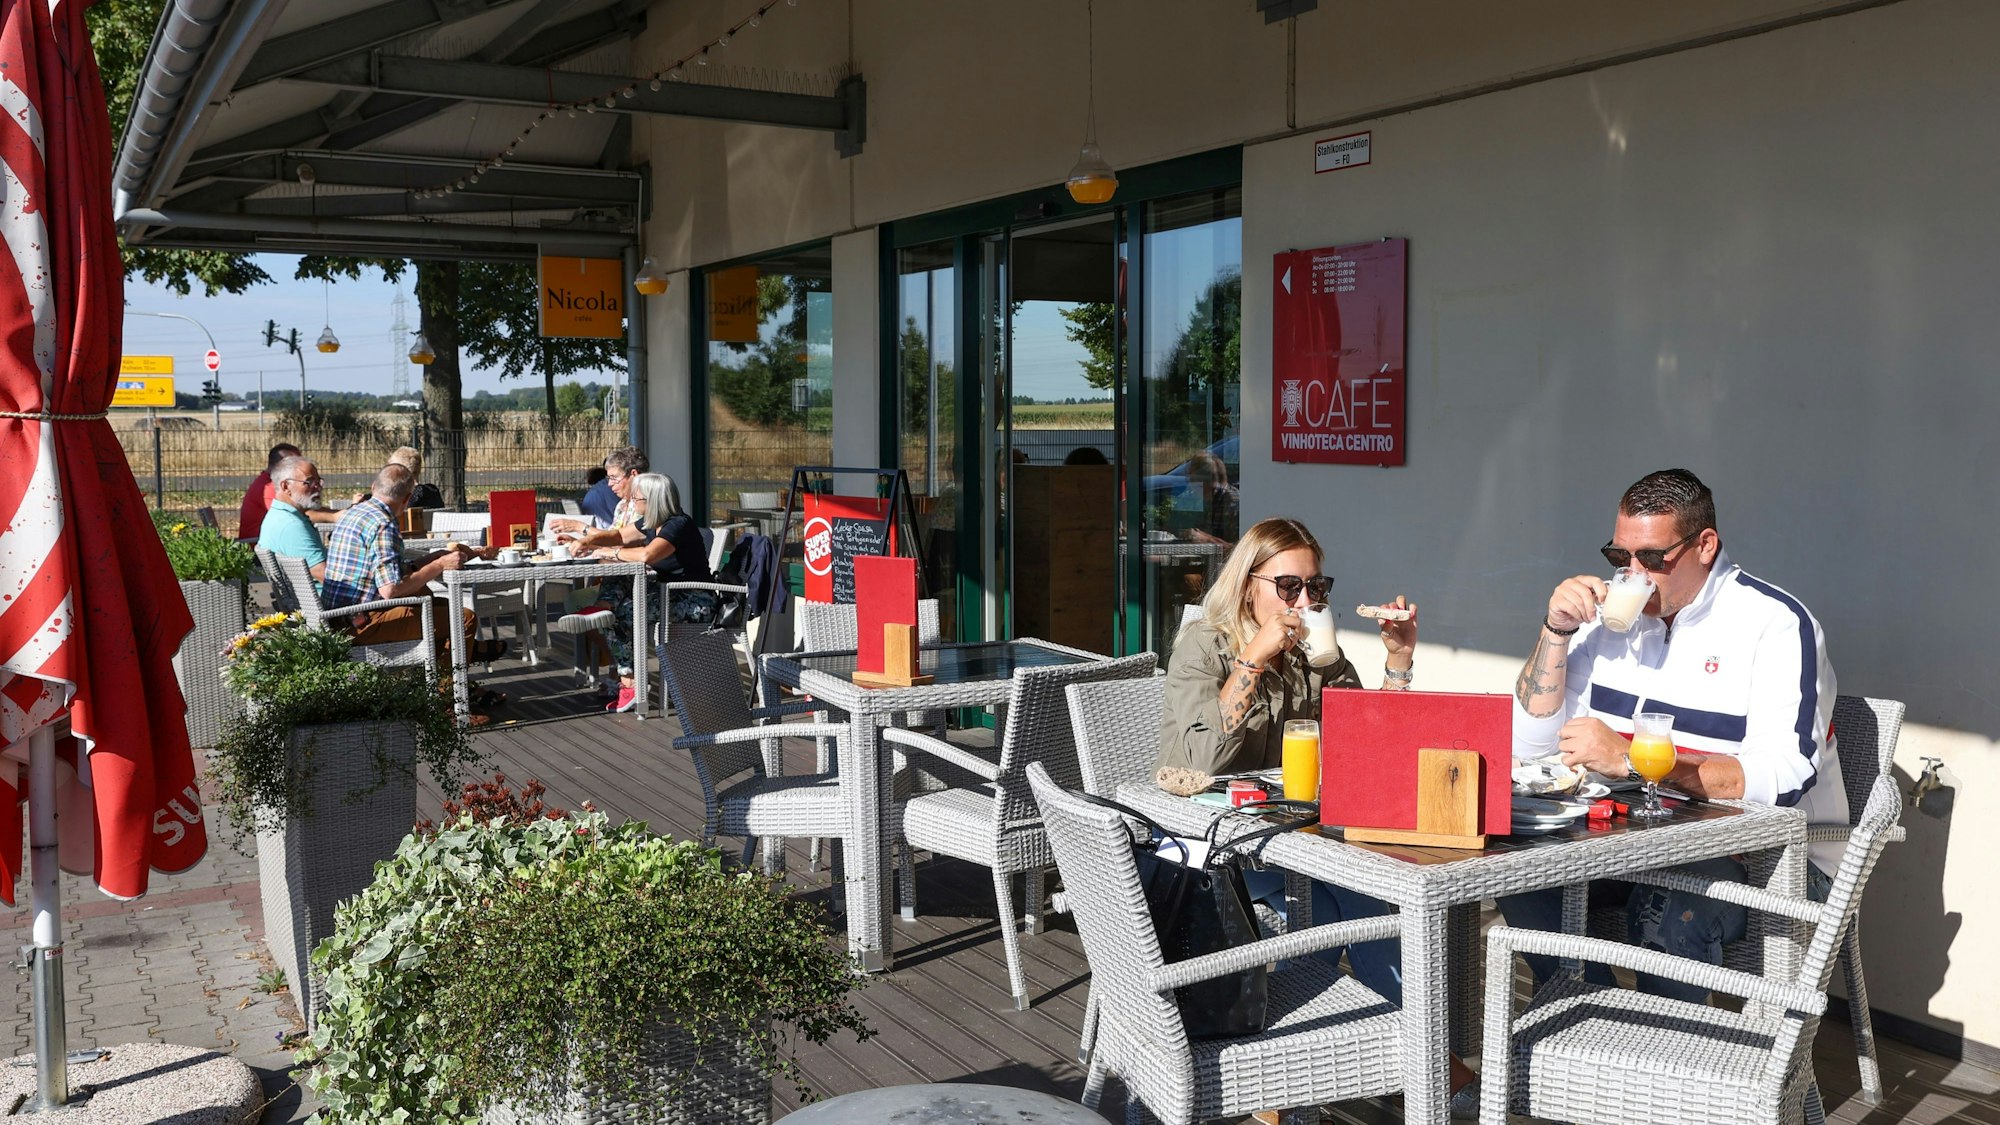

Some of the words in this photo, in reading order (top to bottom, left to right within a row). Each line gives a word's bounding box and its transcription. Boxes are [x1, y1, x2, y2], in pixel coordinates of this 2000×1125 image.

[1317, 138, 1368, 156] Stahlkonstruktion
[547, 287, 618, 311] Nicola
[1305, 363, 1392, 428] CAFÉ
[1281, 433, 1344, 450] VINHOTECA
[1346, 434, 1394, 451] CENTRO
[804, 529, 831, 551] SUPER
[808, 541, 832, 563] BOCK
